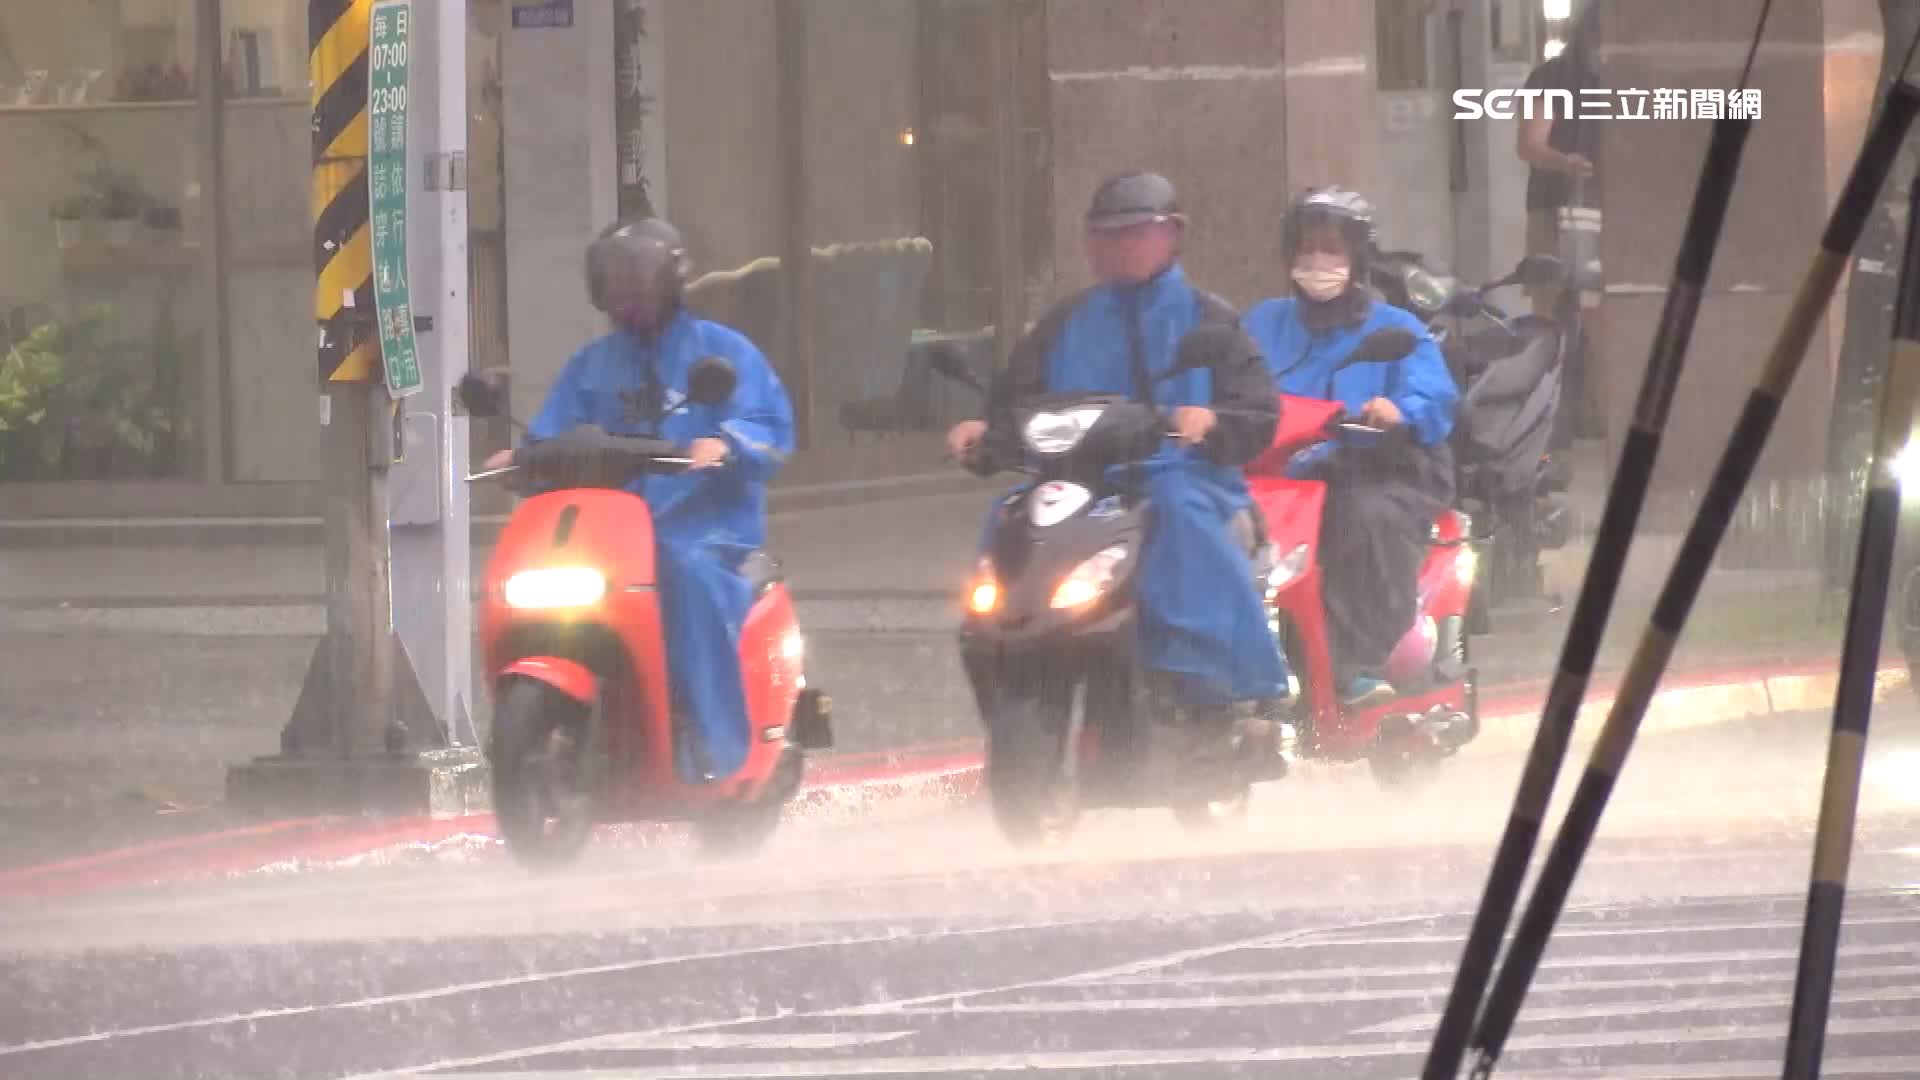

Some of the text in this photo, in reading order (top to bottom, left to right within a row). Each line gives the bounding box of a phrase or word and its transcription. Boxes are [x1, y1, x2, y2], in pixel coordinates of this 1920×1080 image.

[374, 11, 408, 38] 每日
[373, 42, 407, 71] 07:00
[372, 85, 407, 115] 23:00
